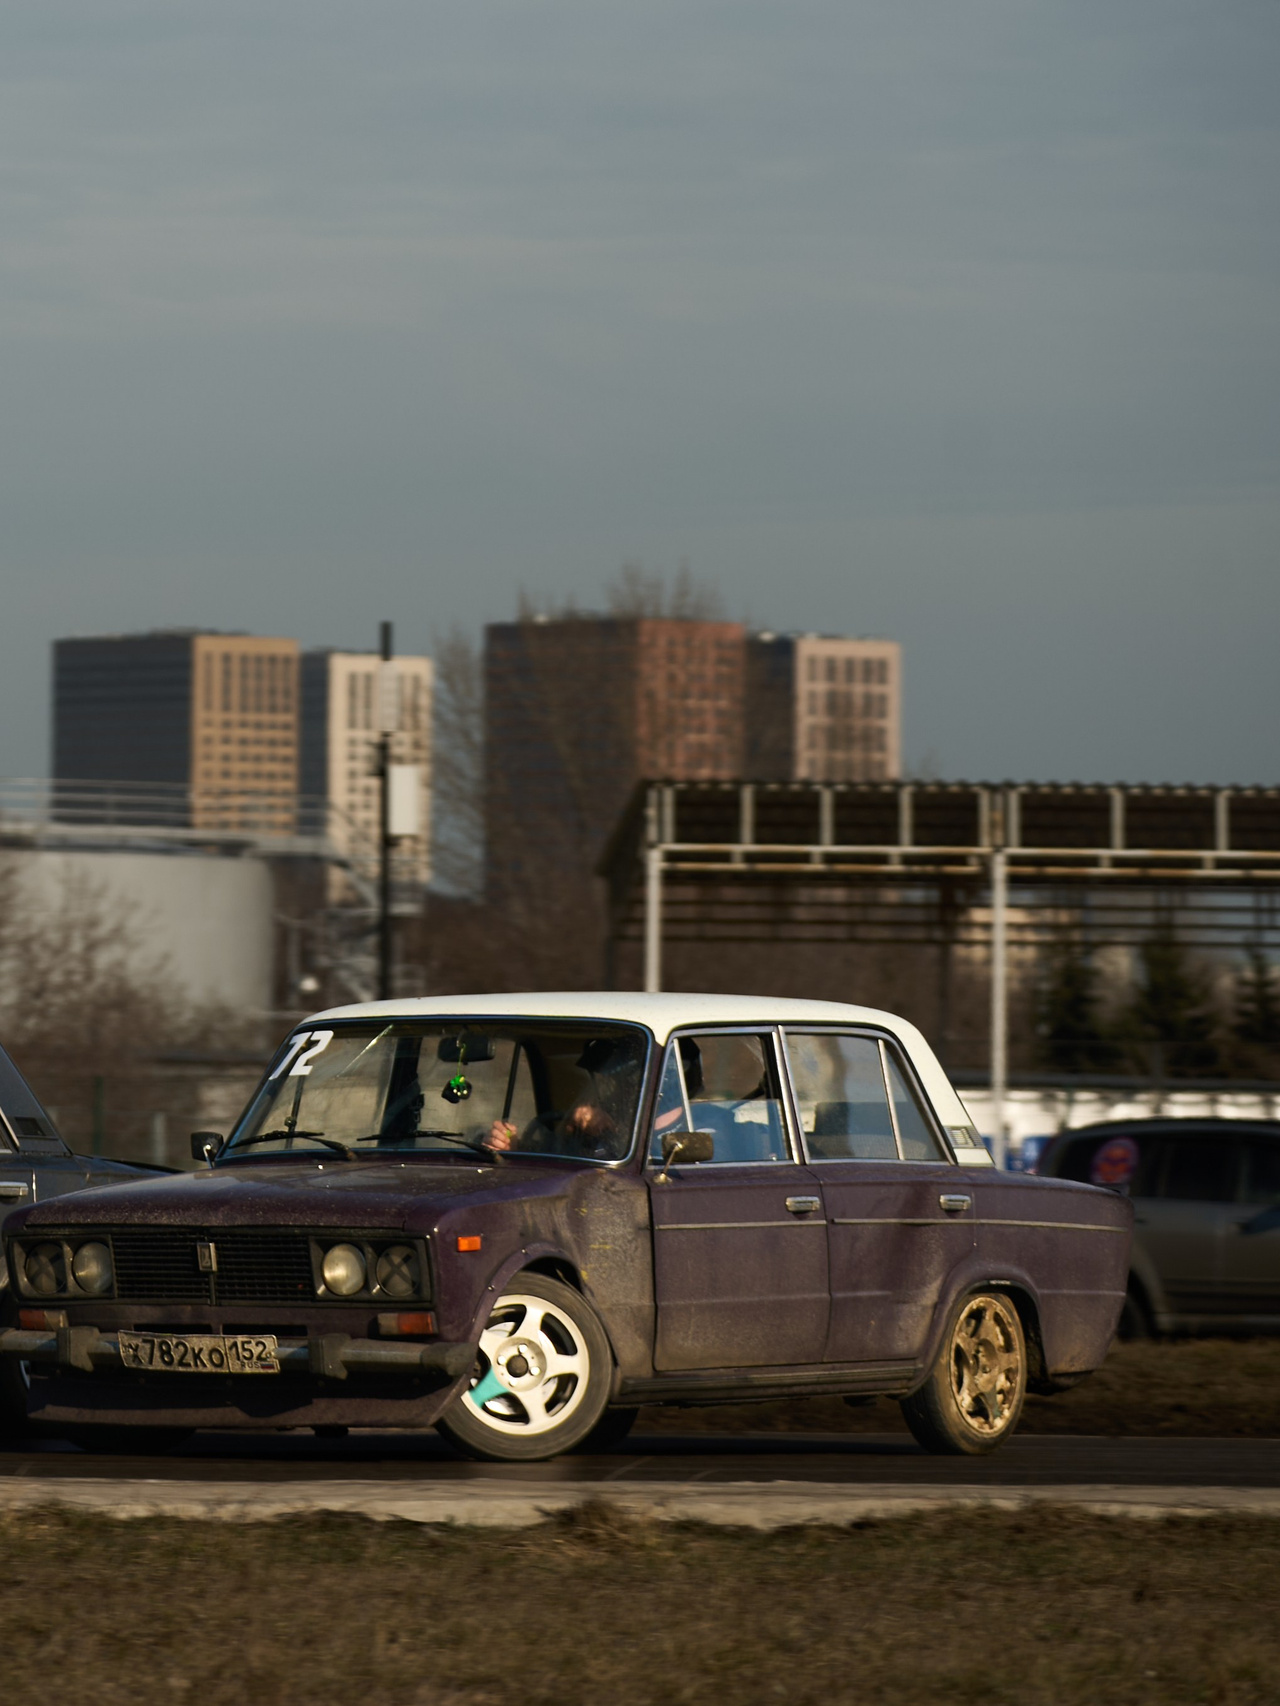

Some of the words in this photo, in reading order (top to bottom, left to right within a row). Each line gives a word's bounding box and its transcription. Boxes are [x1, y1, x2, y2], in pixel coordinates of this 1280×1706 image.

[268, 1029, 334, 1080] 12
[229, 1340, 267, 1361] 152
[241, 1361, 260, 1369] RUS
